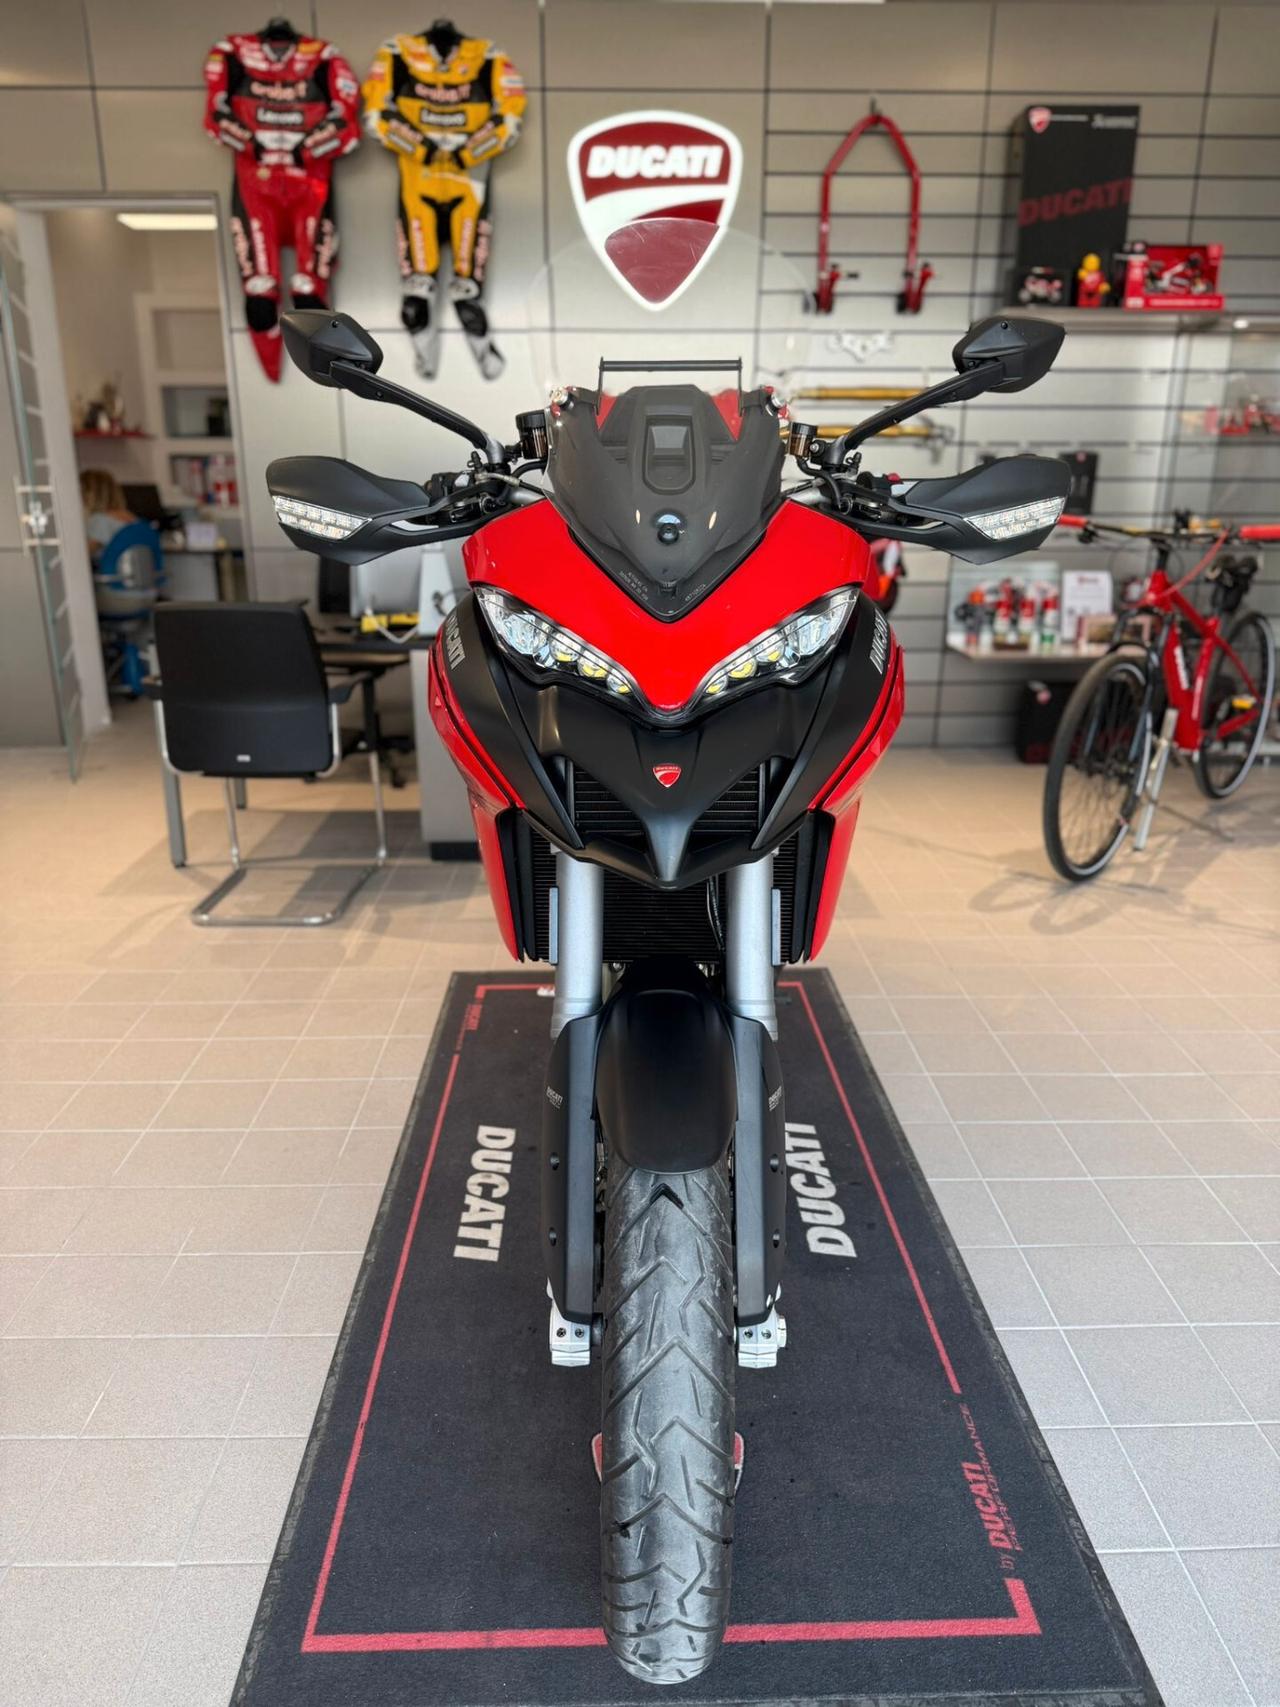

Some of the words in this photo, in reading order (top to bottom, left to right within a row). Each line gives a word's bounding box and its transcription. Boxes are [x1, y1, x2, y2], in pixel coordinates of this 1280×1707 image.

[586, 144, 724, 178] DUCATI
[1018, 176, 1134, 228] DUCATI
[453, 1125, 516, 1261] DUCATI
[784, 1122, 857, 1258] DUCATI
[961, 1462, 1013, 1550] DUCATI
